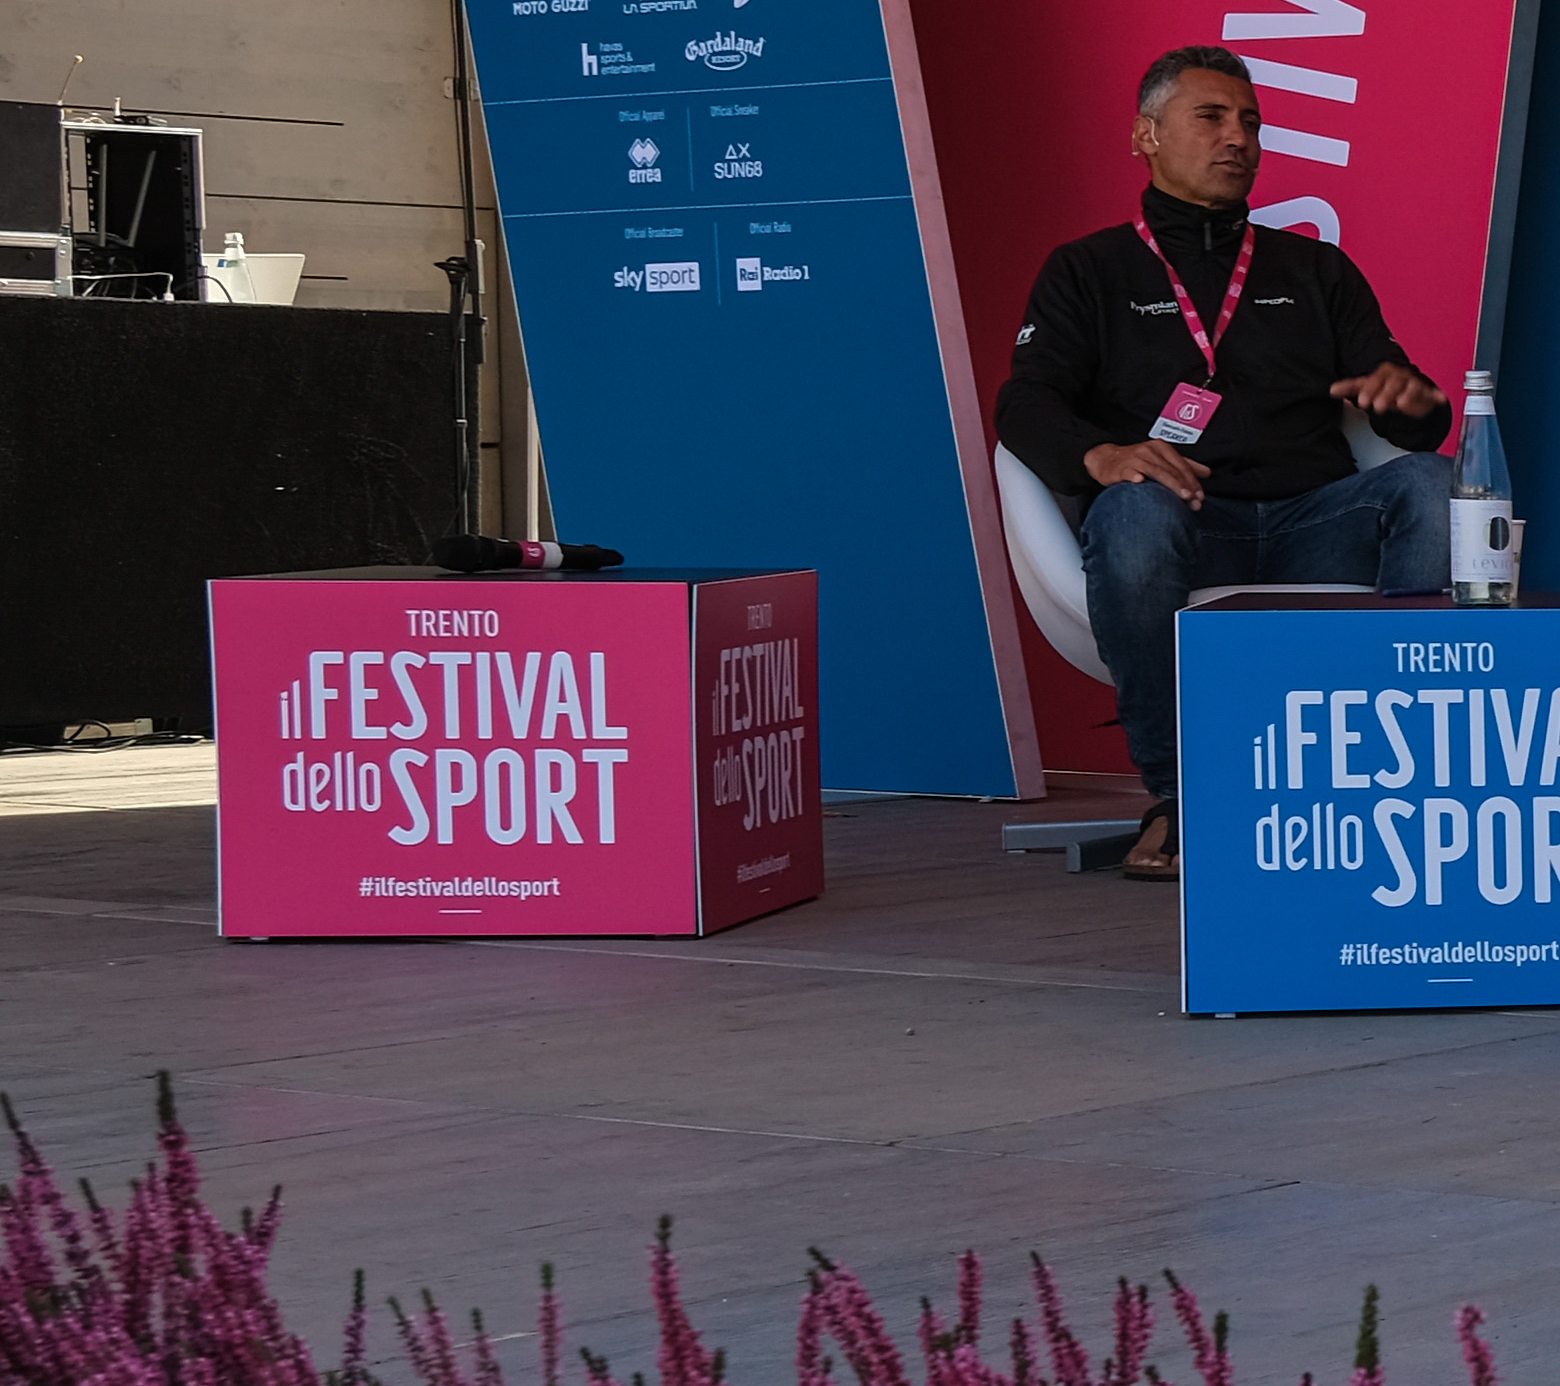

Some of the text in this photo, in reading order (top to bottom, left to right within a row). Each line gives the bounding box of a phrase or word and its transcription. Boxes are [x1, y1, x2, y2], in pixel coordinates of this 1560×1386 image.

[512, 0, 548, 16] MOTO
[685, 30, 766, 61] Gardaland
[619, 110, 640, 122] Official
[710, 105, 733, 117] Official
[628, 168, 662, 184] errea
[714, 161, 763, 179] SUN68
[624, 228, 647, 240] Official
[749, 223, 773, 235] Official
[614, 265, 696, 292] sky sport
[739, 267, 759, 282] Rai
[405, 609, 499, 637] TRENTO
[1393, 641, 1495, 674] TRENTO
[309, 650, 628, 740] FESTIVAL
[720, 638, 804, 735] FESTIVAL
[713, 726, 805, 831] dello SPORT
[282, 747, 629, 846] dello SPORT
[1255, 802, 1365, 871] dello
[359, 875, 560, 900] #ilfestivaldellosport
[1339, 941, 1560, 967] #ilfestivaldellosport
